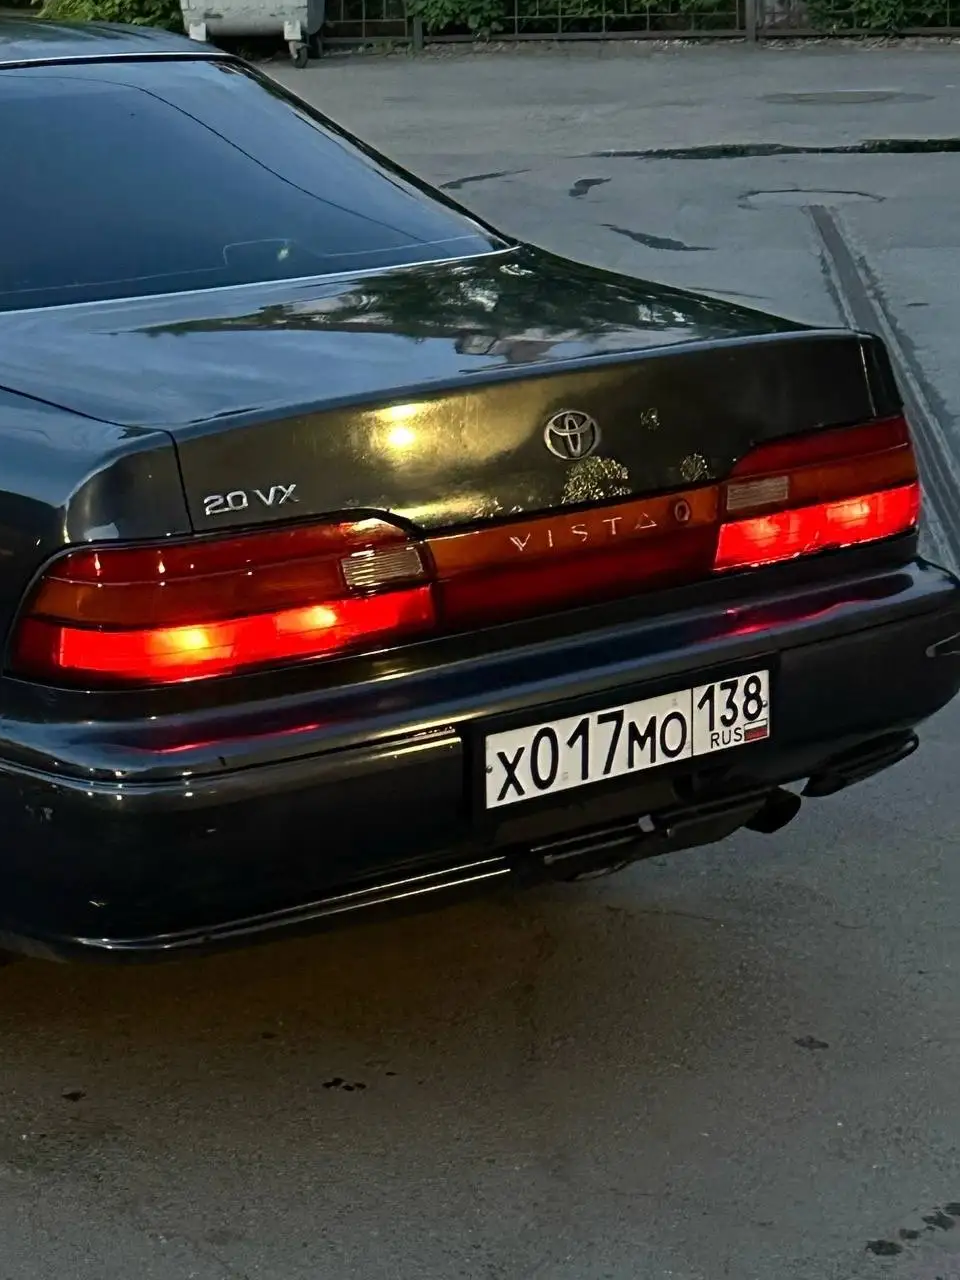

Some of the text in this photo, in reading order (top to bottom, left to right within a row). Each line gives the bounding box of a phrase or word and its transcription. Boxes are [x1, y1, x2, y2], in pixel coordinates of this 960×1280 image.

[203, 484, 299, 516] 20 VX
[509, 513, 657, 552] VISTA
[697, 675, 762, 731] 138
[711, 728, 742, 749] RUS
